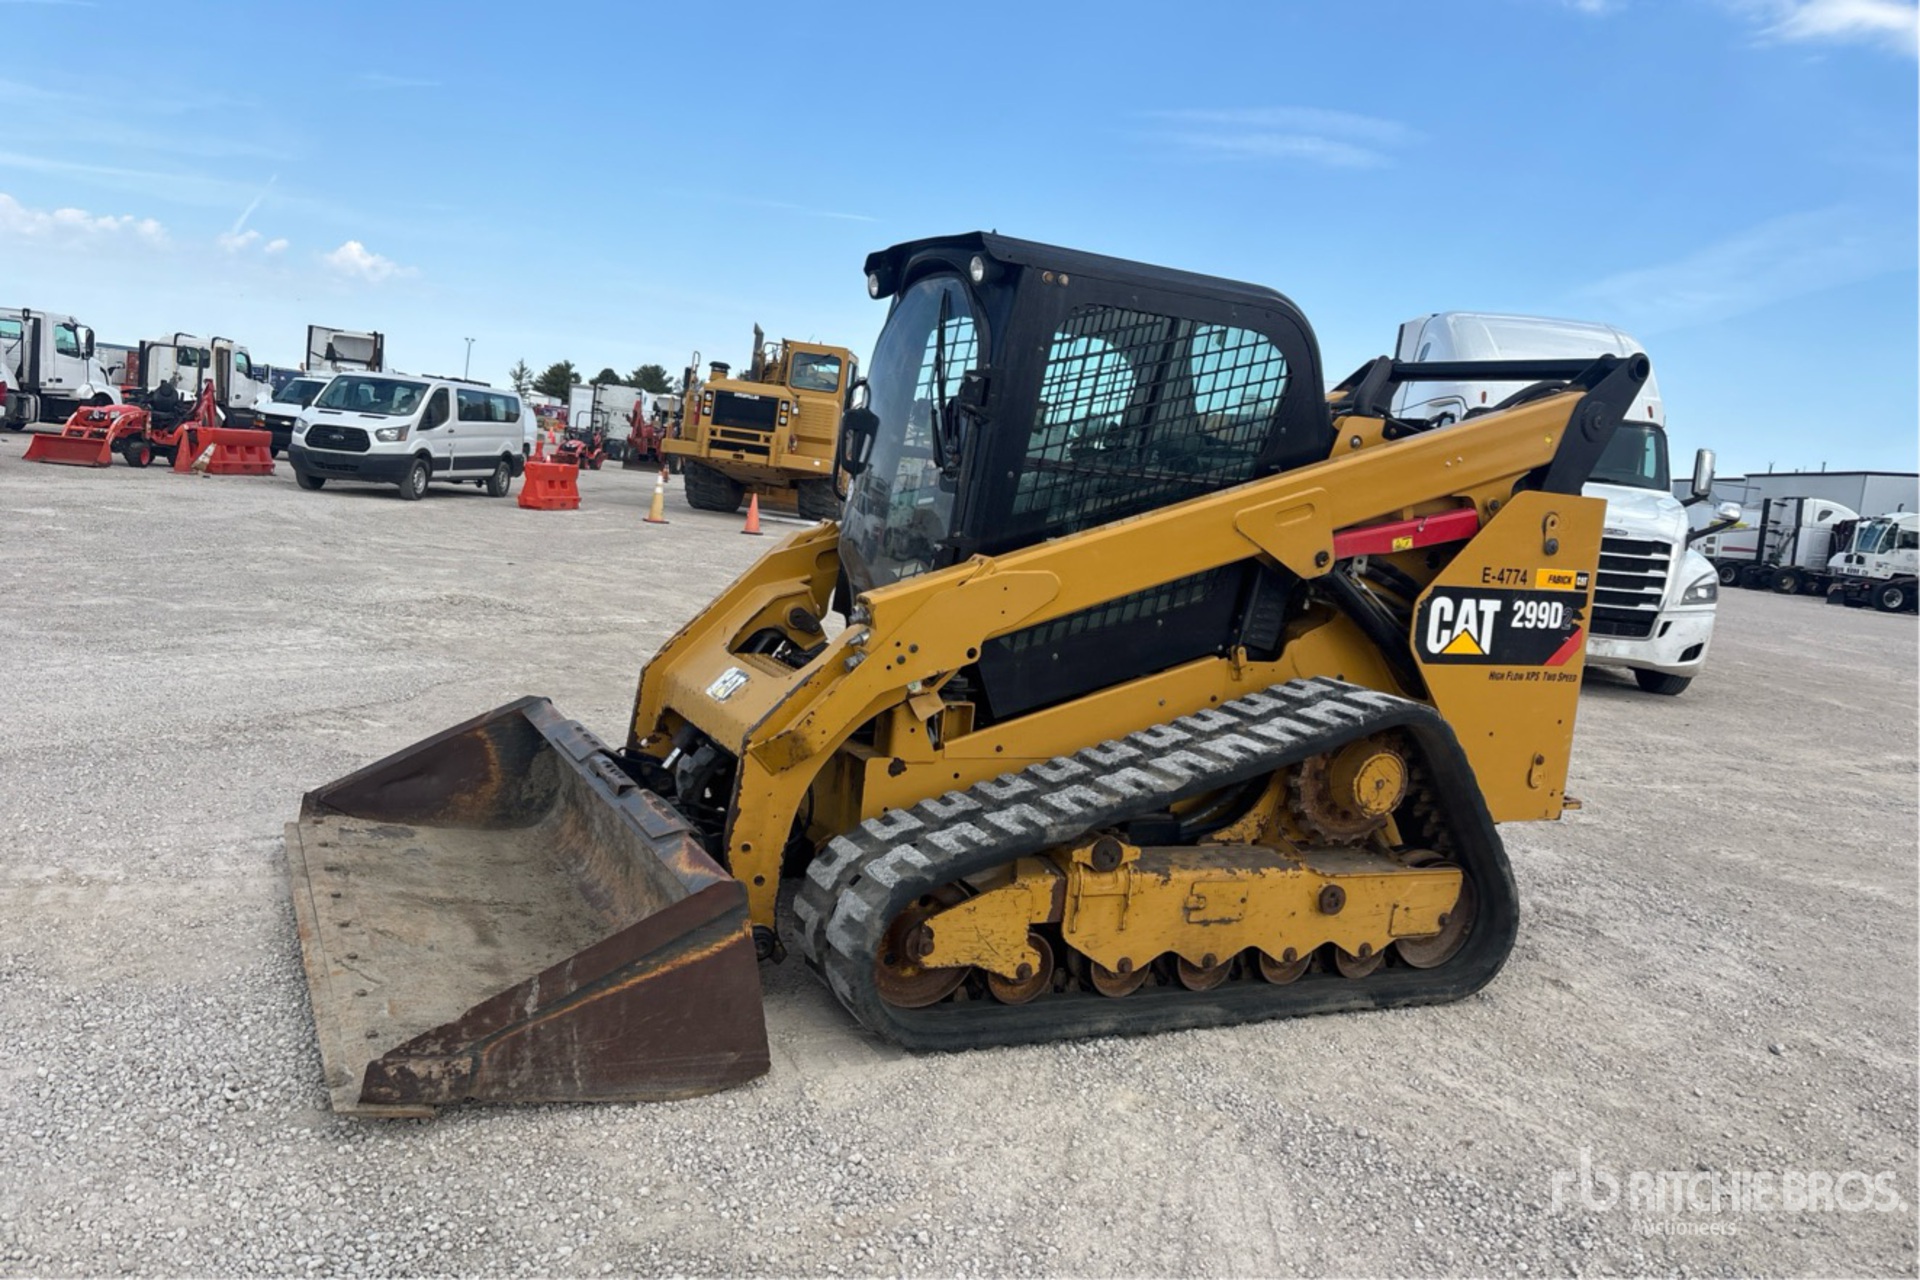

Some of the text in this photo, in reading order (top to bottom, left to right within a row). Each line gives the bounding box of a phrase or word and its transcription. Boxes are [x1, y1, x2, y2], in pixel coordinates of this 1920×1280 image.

[1482, 567, 1527, 585] E-4774
[1547, 574, 1588, 586] FABICK CAT
[1427, 596, 1502, 655] CAT
[1526, 671, 1541, 681] XPS
